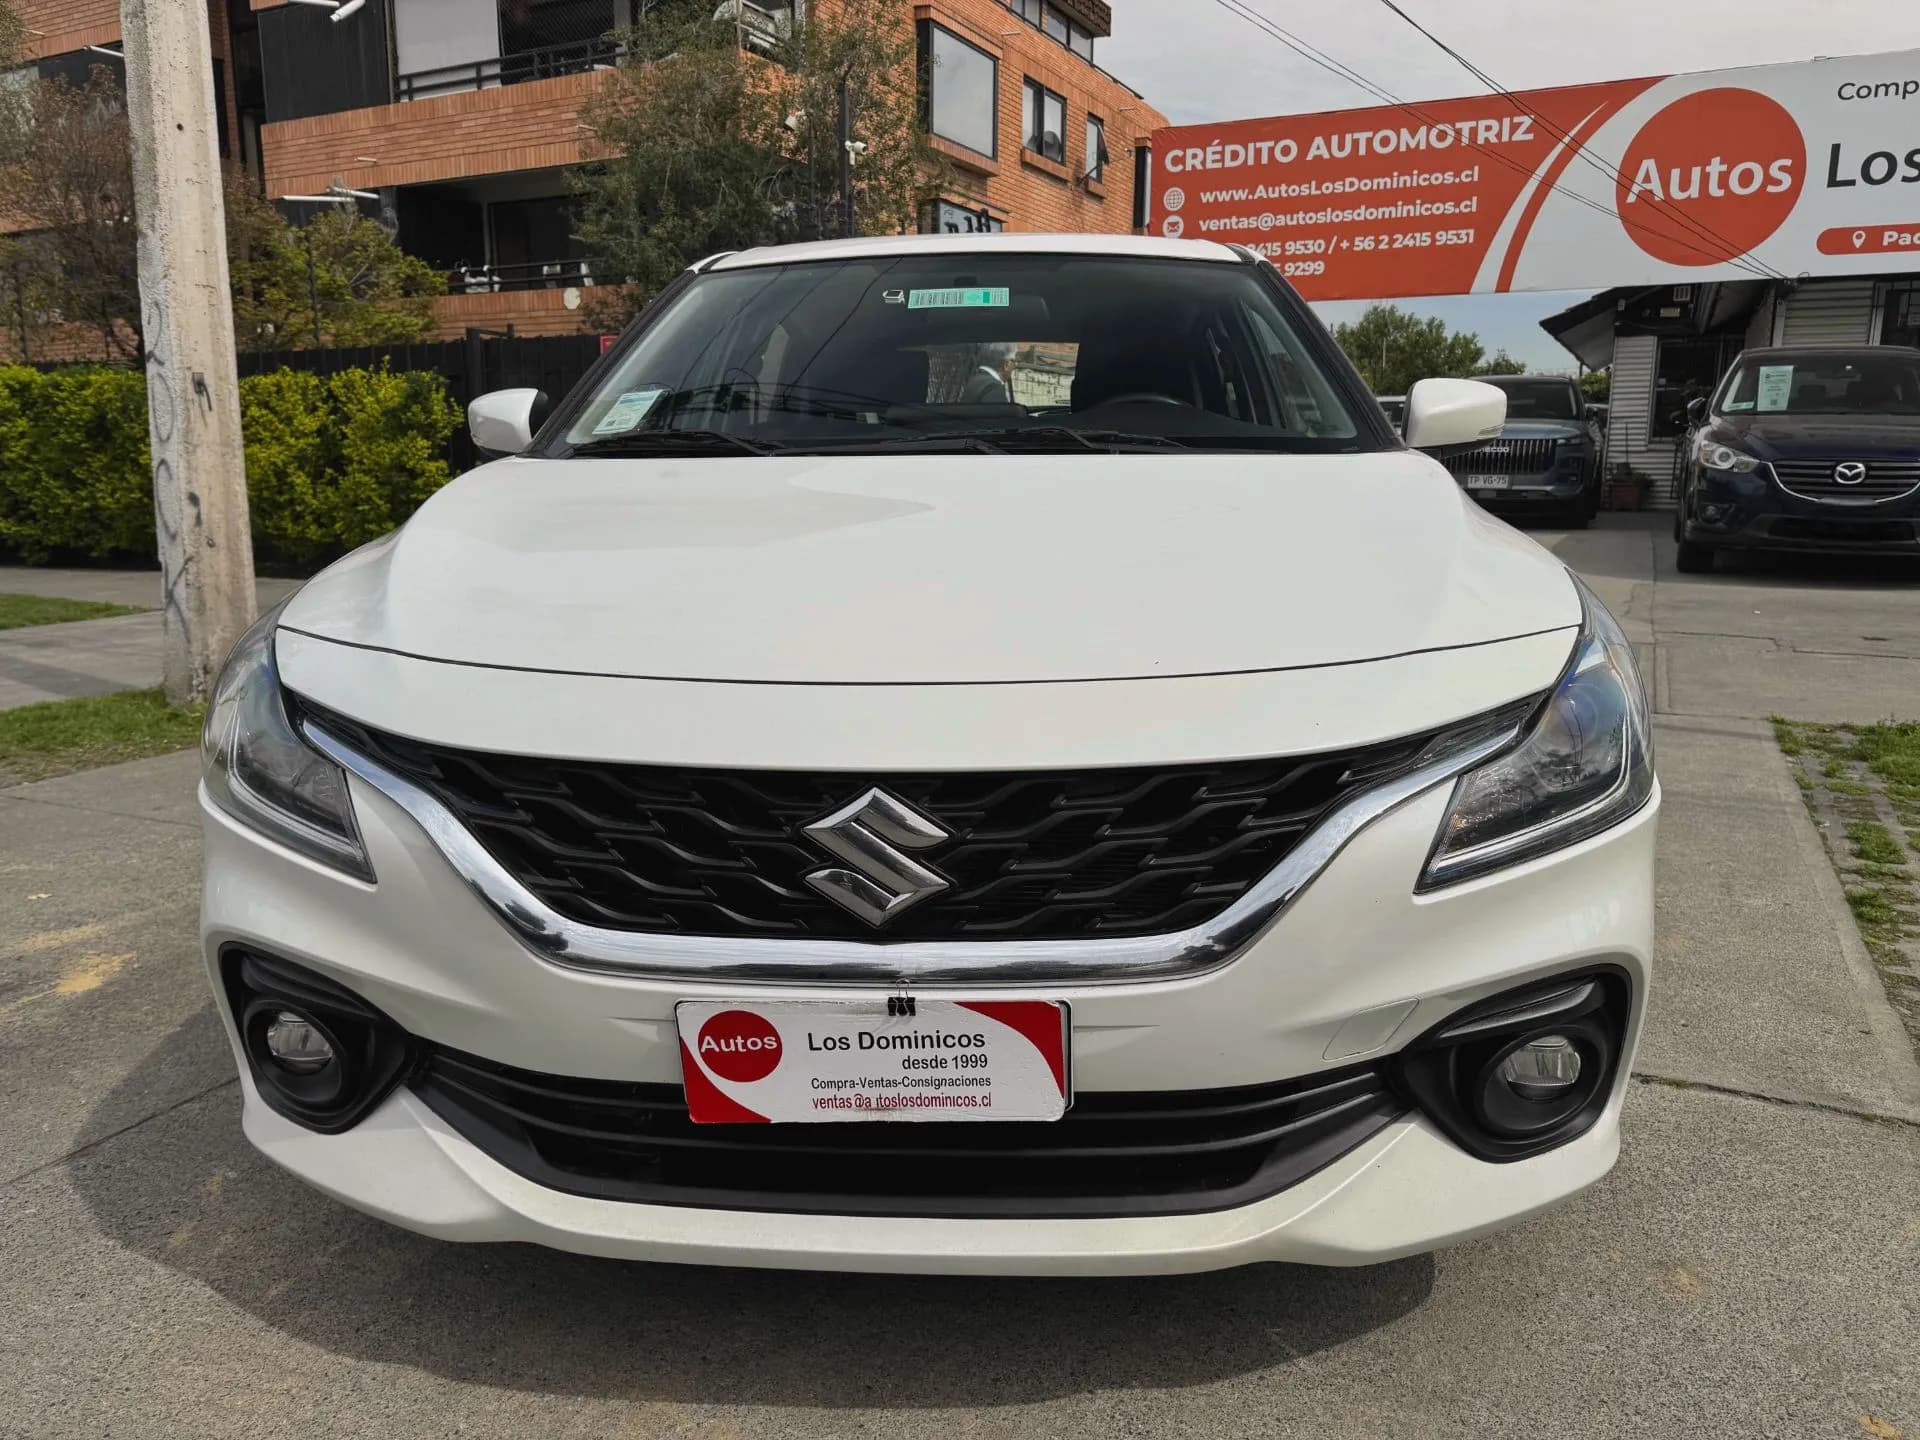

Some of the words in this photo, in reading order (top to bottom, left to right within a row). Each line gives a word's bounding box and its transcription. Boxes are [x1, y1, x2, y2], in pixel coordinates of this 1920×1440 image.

[1164, 139, 1298, 173] CRÉDITO
[1306, 115, 1535, 161] AUTOMOTRIZ
[1200, 165, 1479, 204] www.AutosLosDominicos.cl
[1625, 155, 1793, 204] Autos
[1199, 196, 1478, 232] ventas@autoslosdominicos.cl
[1284, 239, 1326, 256] 9530
[1353, 235, 1375, 252] 56
[1378, 234, 1389, 250] 2
[1392, 231, 1432, 249] 2415
[1435, 228, 1475, 246] 9531
[1284, 260, 1325, 277] 9299
[700, 1033, 778, 1053] Autos
[807, 1031, 851, 1052] Los
[858, 1029, 986, 1050] Dominicos
[901, 1054, 948, 1070] desde
[951, 1053, 988, 1070] 1999
[811, 1075, 992, 1092] Compra-Ventas-Consignaciones
